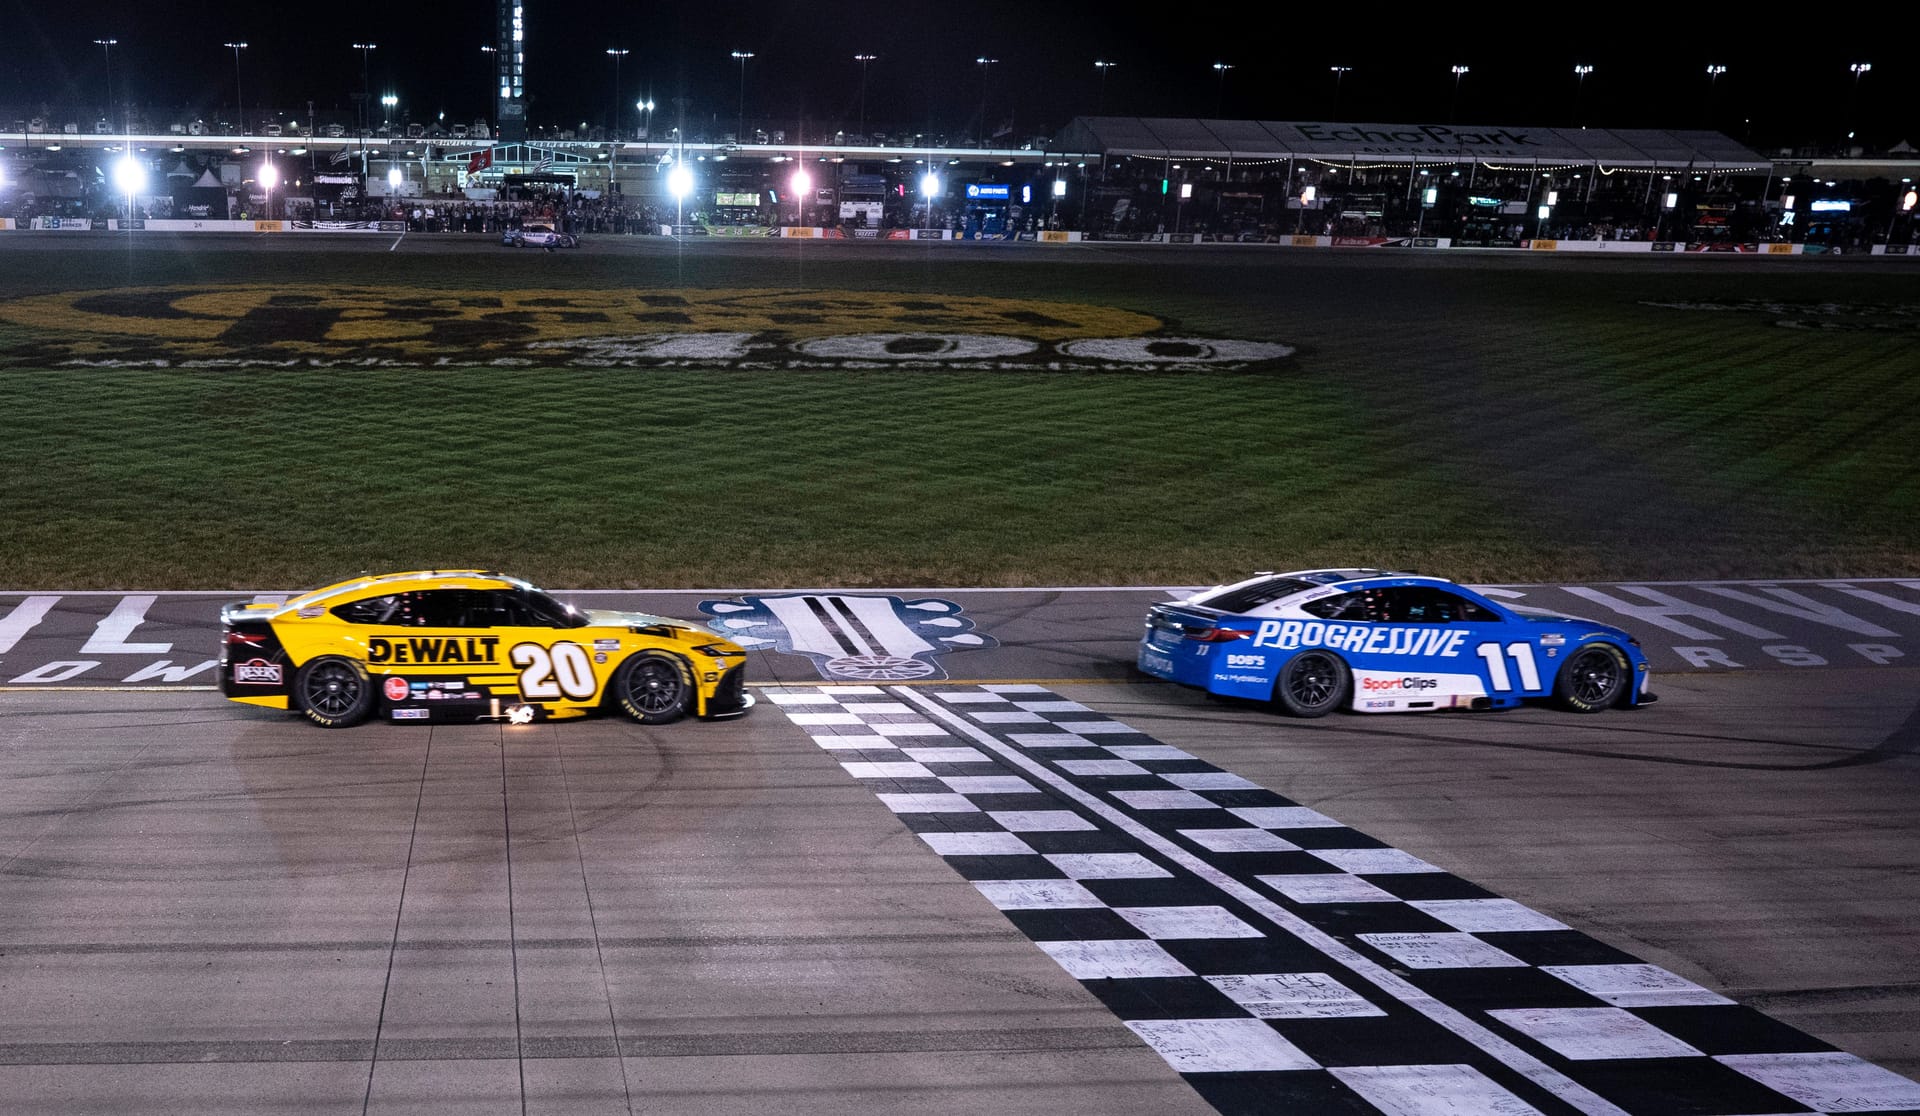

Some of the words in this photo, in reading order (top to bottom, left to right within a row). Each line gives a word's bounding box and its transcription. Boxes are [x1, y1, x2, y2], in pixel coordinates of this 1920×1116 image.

[1295, 124, 1542, 147] EchoPark
[1253, 620, 1470, 658] PROGRESSIVE
[508, 640, 598, 703] 20
[1227, 655, 1266, 666] BOB'S
[1475, 641, 1542, 692] 11
[305, 708, 333, 726] EAGLE
[621, 698, 645, 720] EAGLE
